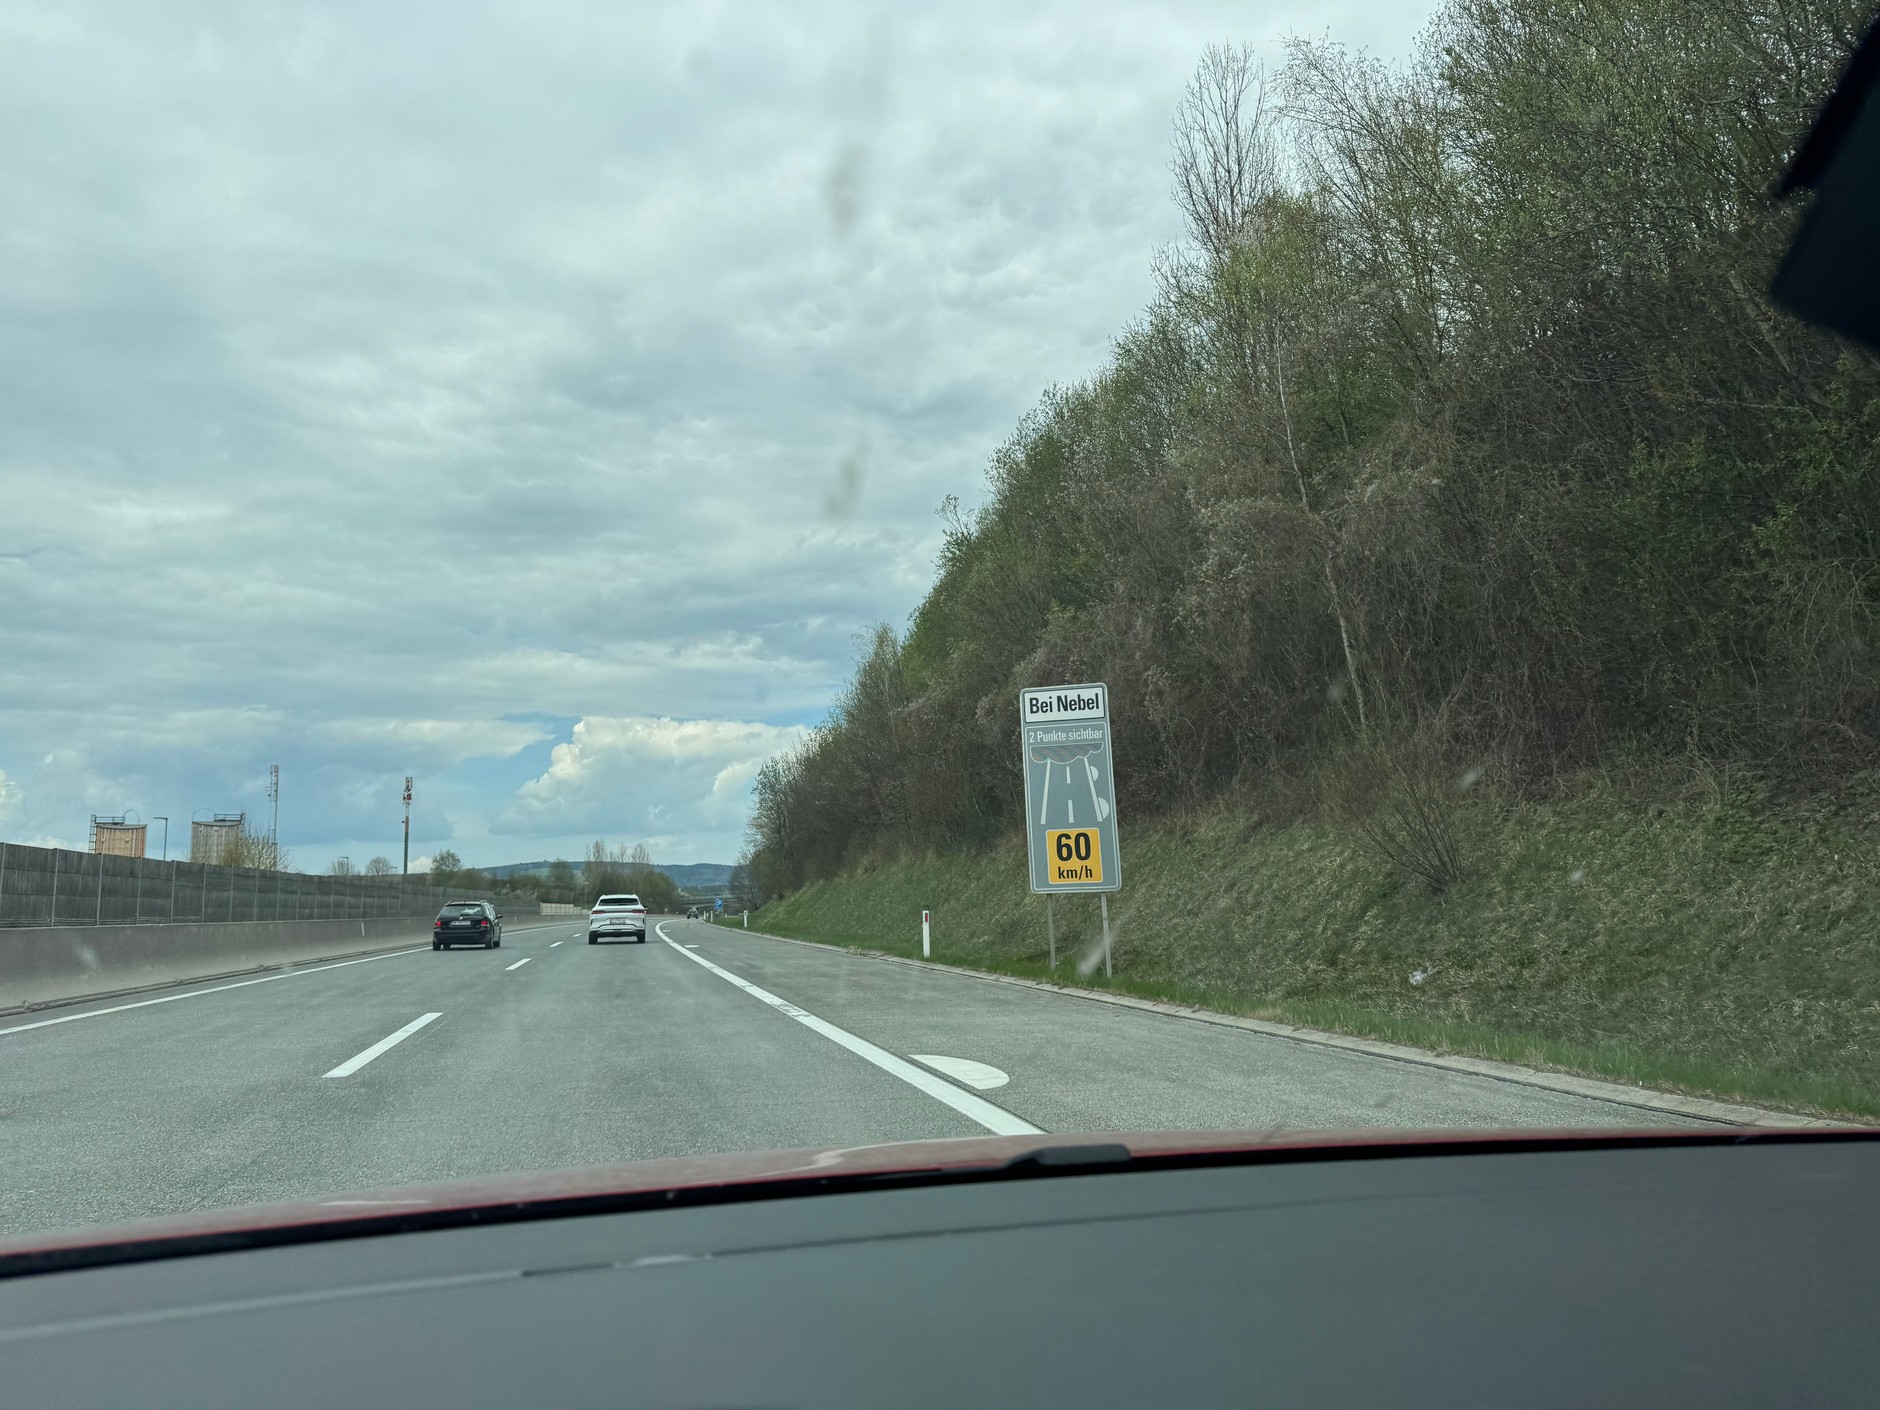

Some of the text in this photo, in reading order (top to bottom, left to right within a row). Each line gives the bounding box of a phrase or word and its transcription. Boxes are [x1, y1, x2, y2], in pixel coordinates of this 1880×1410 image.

[1029, 693, 1099, 714] Bei Nebel
[1029, 728, 1103, 743] 2 Punkte sichtbar
[1056, 832, 1091, 861] 60
[1058, 865, 1093, 880] km/h
